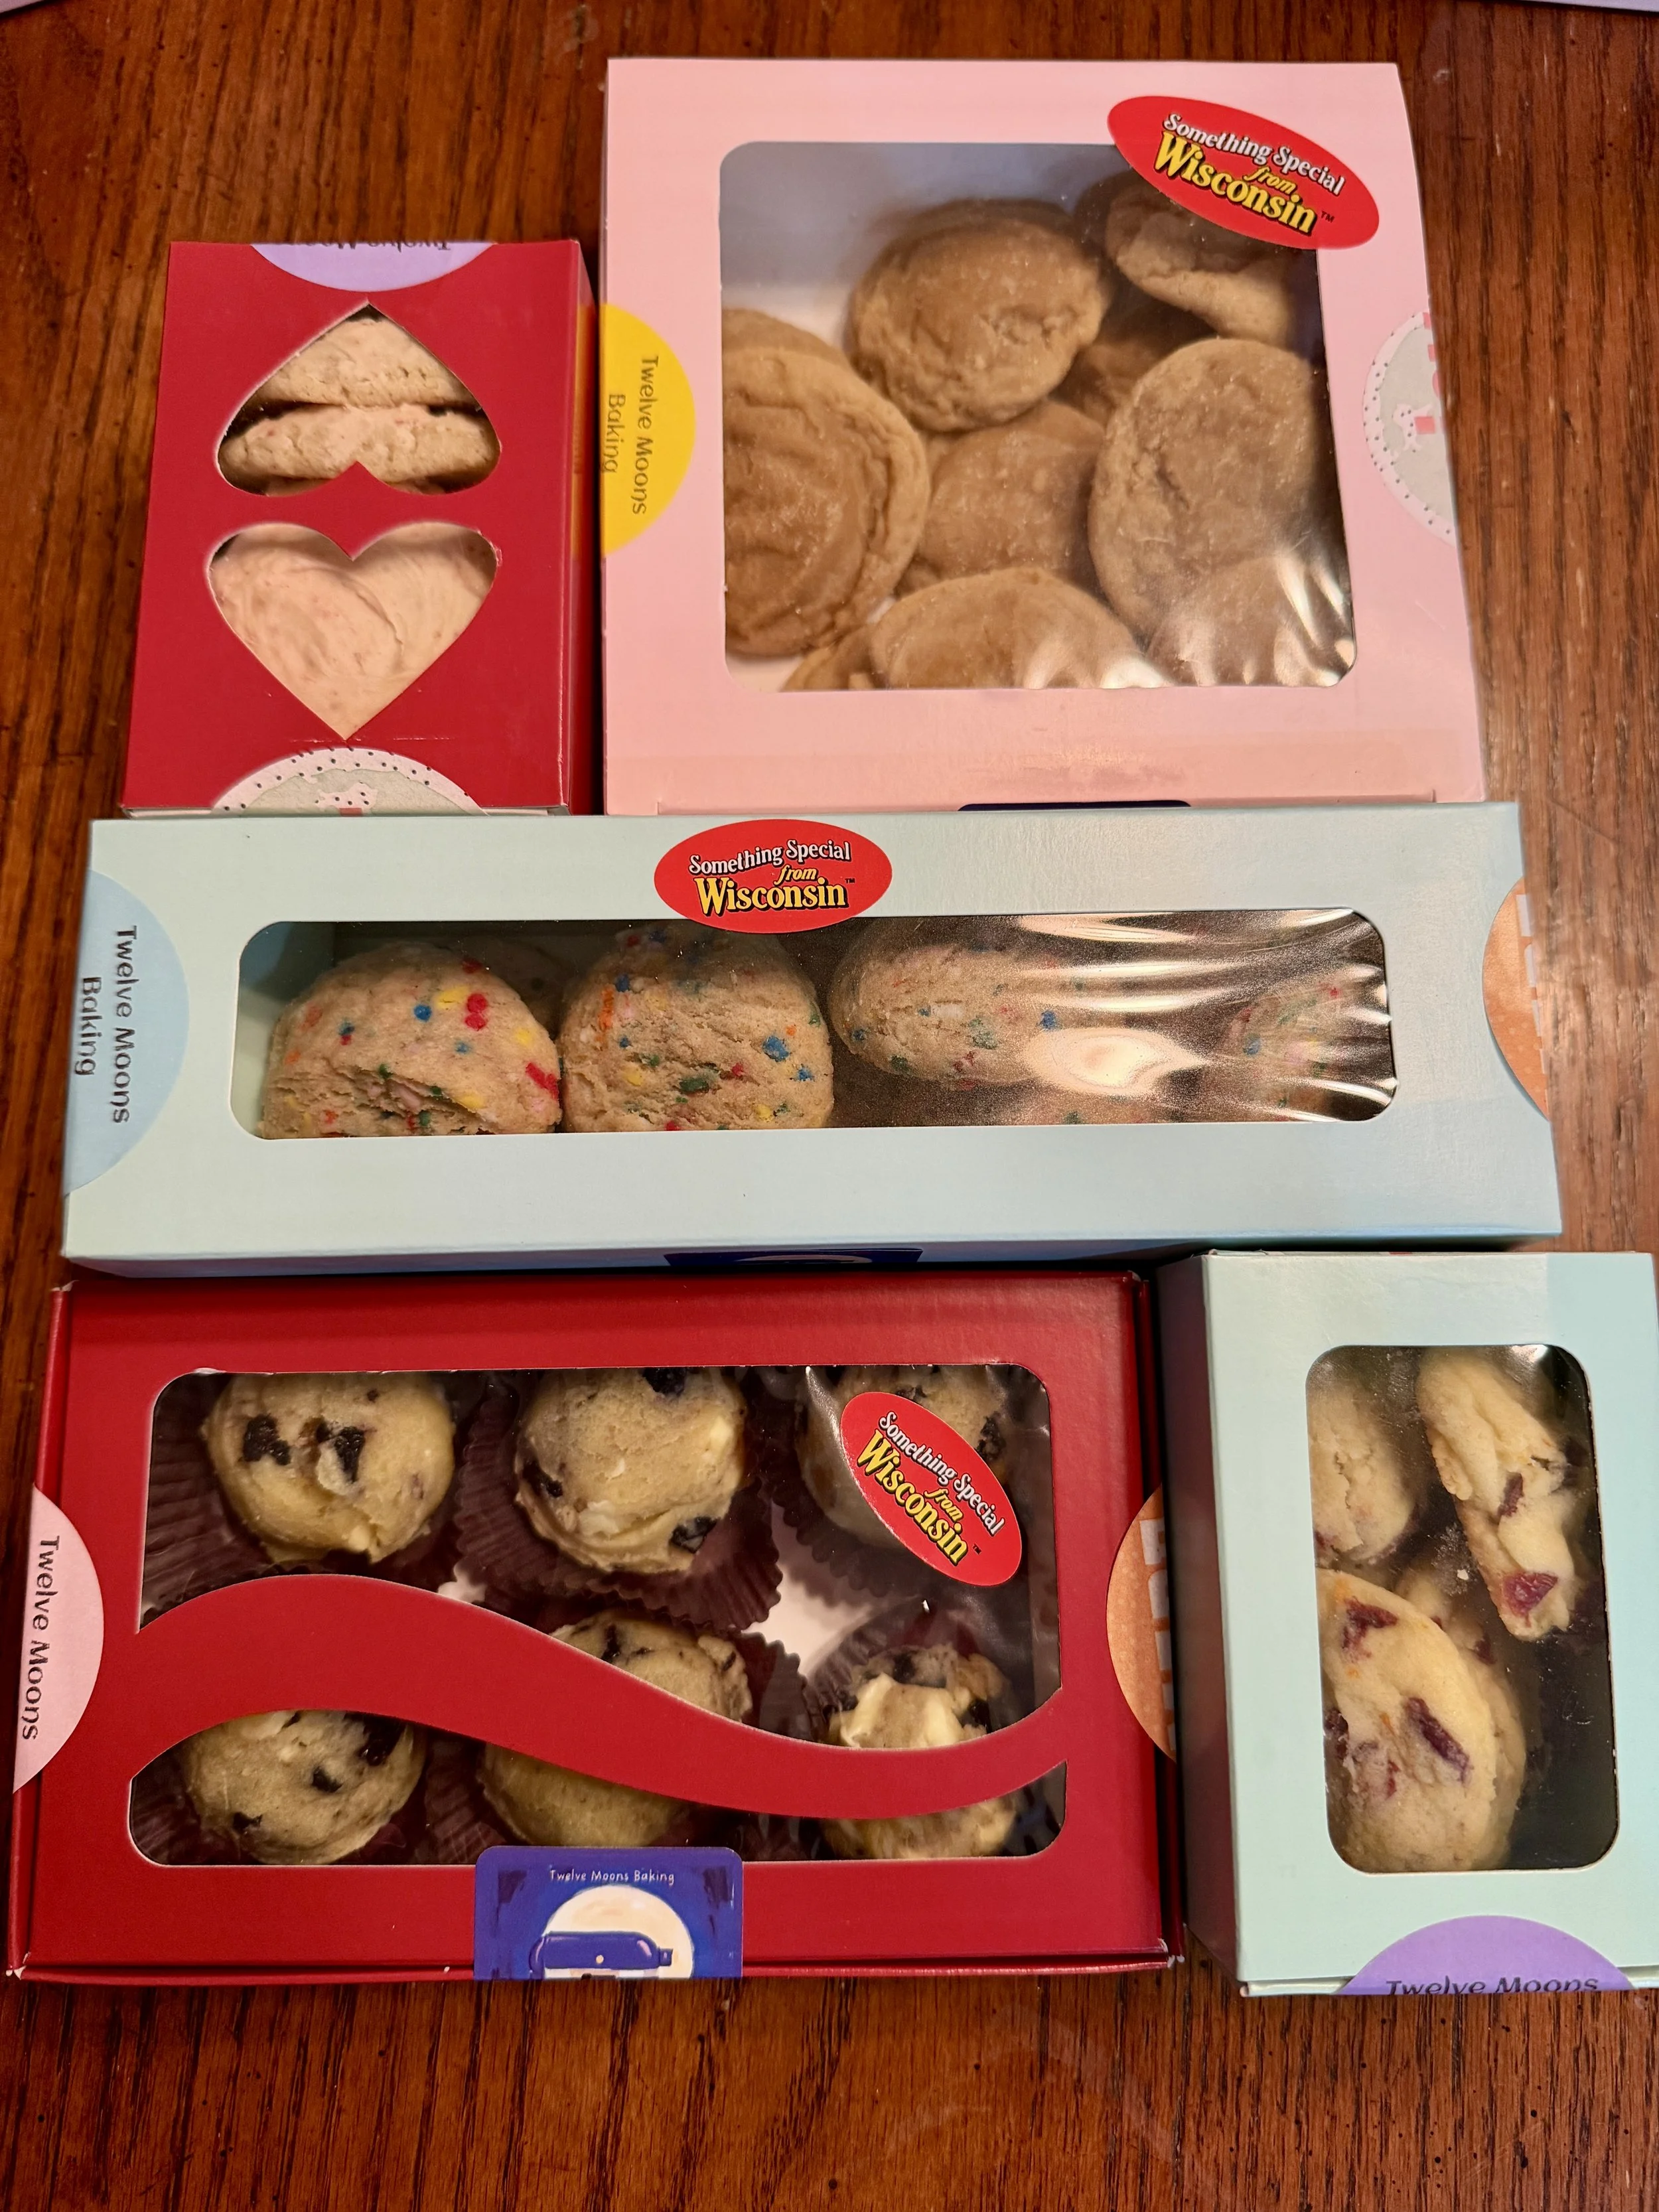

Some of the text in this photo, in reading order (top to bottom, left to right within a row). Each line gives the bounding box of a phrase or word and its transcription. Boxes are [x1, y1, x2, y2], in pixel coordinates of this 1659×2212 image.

[1153, 130, 1317, 236] Wisconsin
[1163, 113, 1346, 196] Something Special
[1244, 166, 1297, 196] from
[602, 394, 626, 473] Baking
[632, 355, 659, 515] Twelve Moons
[689, 840, 851, 875] Something Special
[694, 877, 849, 917] Wisconsin
[774, 864, 818, 885] from
[75, 976, 103, 1076] Baking
[110, 925, 139, 1124] Twelve Moons
[857, 1429, 968, 1566] Wisconsin
[879, 1412, 1005, 1536] Something Special
[924, 1488, 964, 1522] from
[21, 1535, 60, 1741] Twelve Moons
[549, 1868, 675, 1885] Twelve Moons Baking
[1386, 1975, 1599, 1996] Twelve Moons
